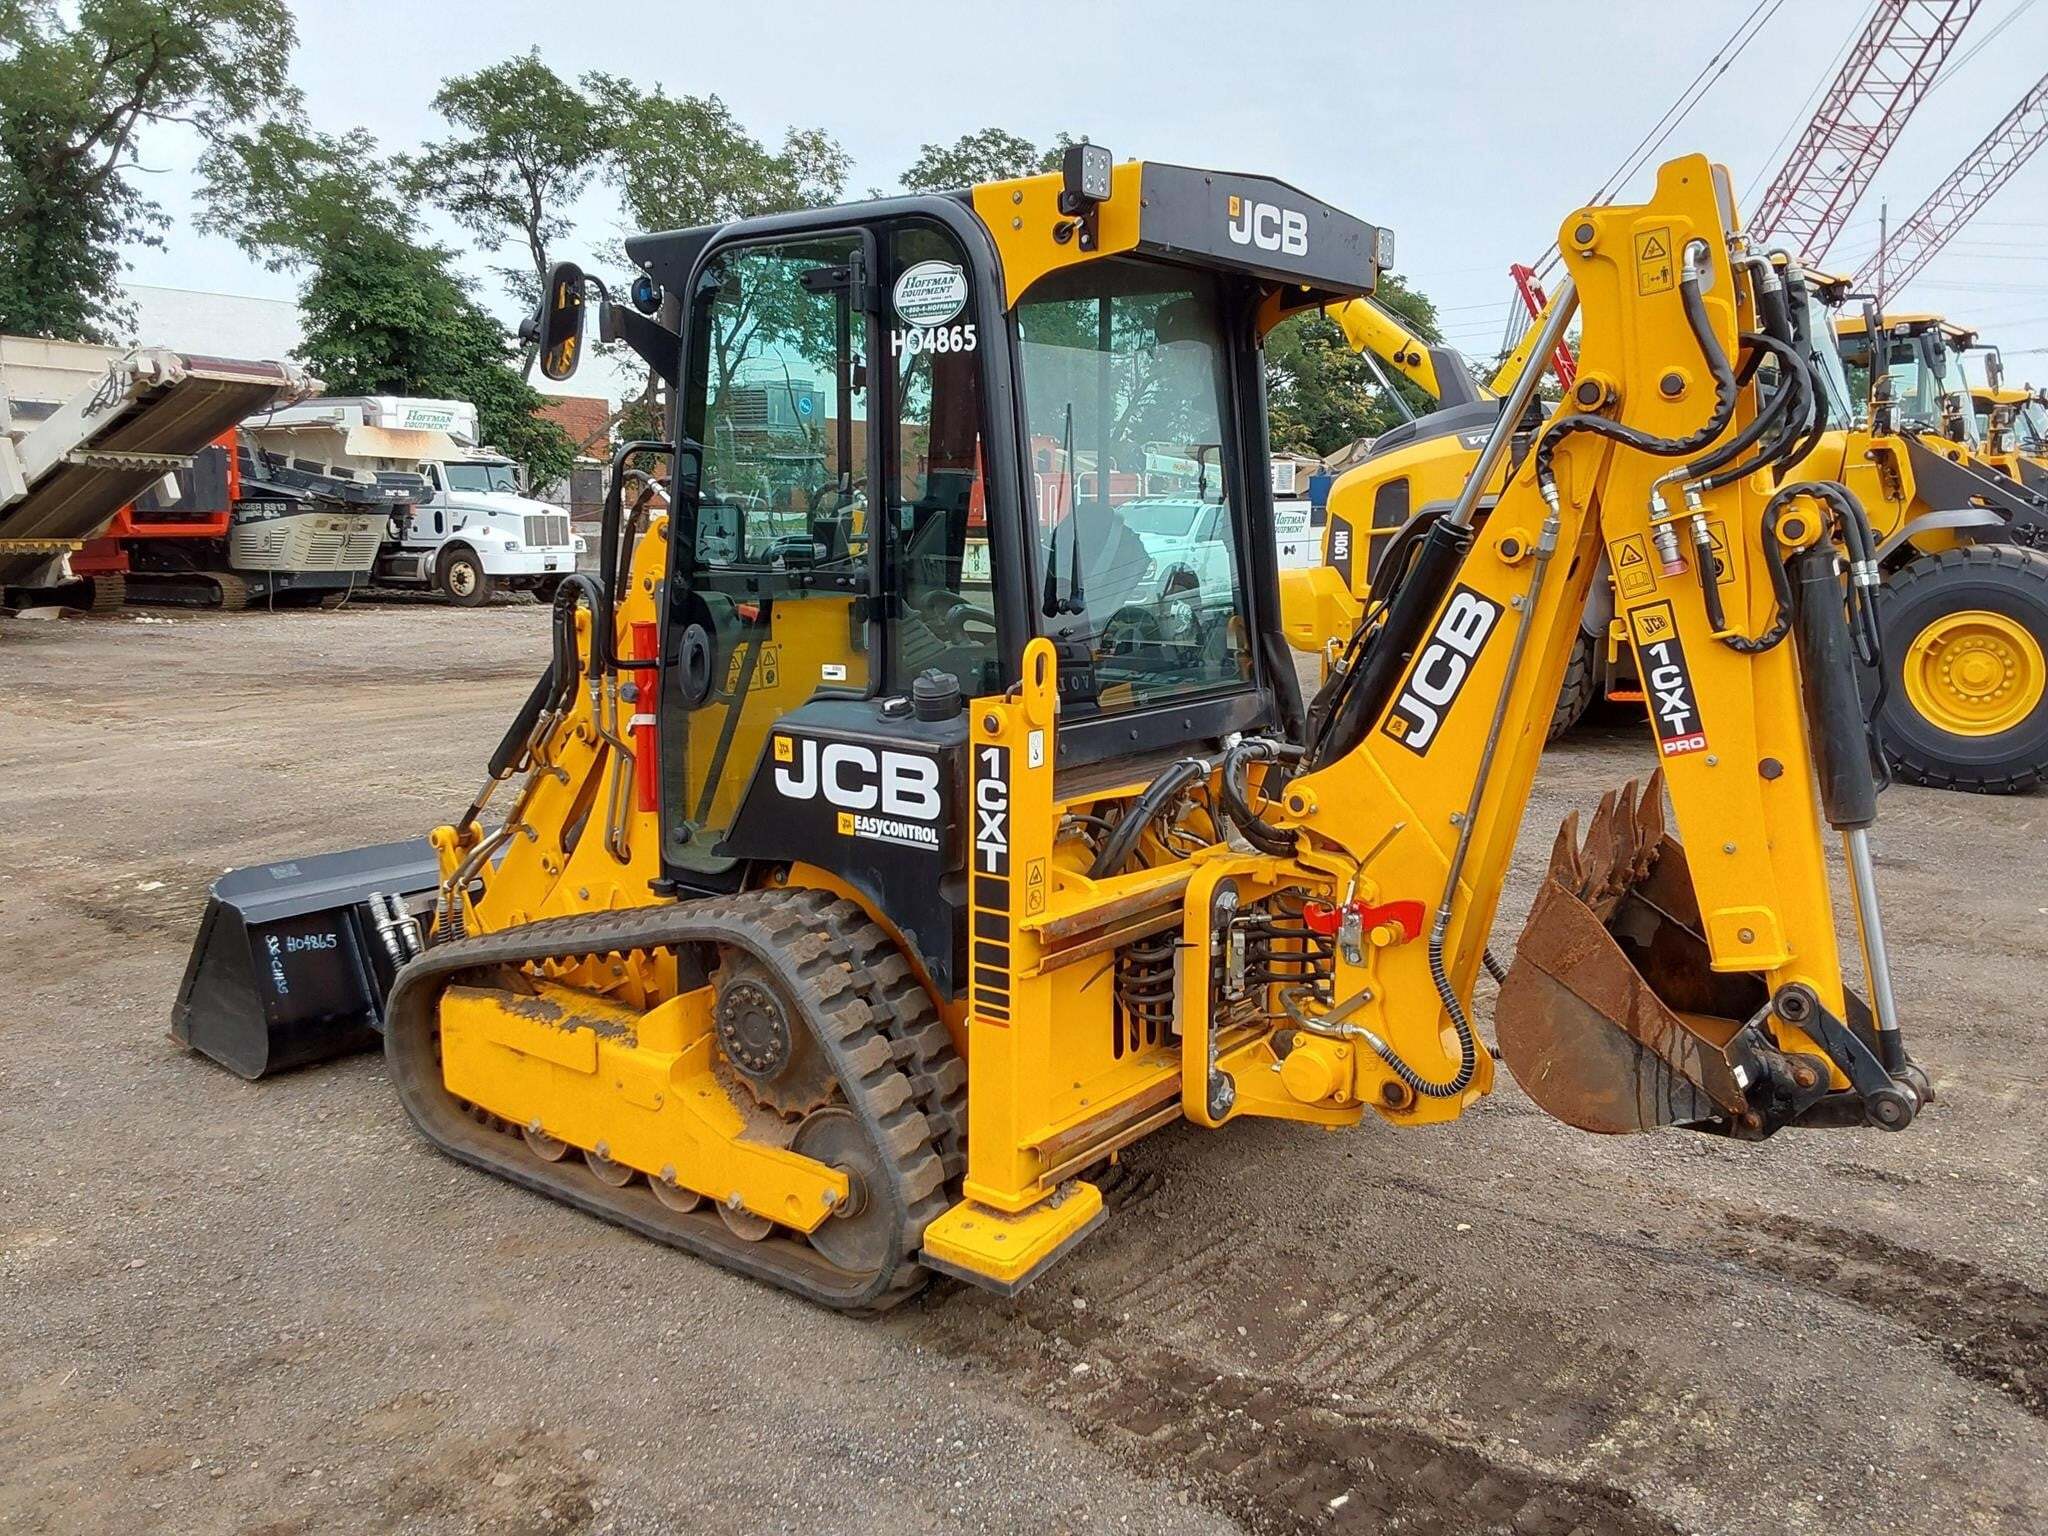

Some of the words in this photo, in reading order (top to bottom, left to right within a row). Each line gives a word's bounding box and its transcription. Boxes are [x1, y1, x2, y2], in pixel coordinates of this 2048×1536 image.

[1228, 199, 1308, 257] JCB
[901, 285, 953, 299] EQUIPMENT
[903, 275, 957, 290] HOFFMAN
[406, 409, 453, 423] HOFFMAN
[1334, 530, 1349, 560] L90H
[1643, 616, 1666, 634] JCB
[1398, 591, 1496, 749] JCB
[1648, 641, 1692, 736] 1CXT
[1663, 736, 1705, 755] PRO
[774, 739, 942, 821] JCB
[976, 747, 1008, 874] 1CXT
